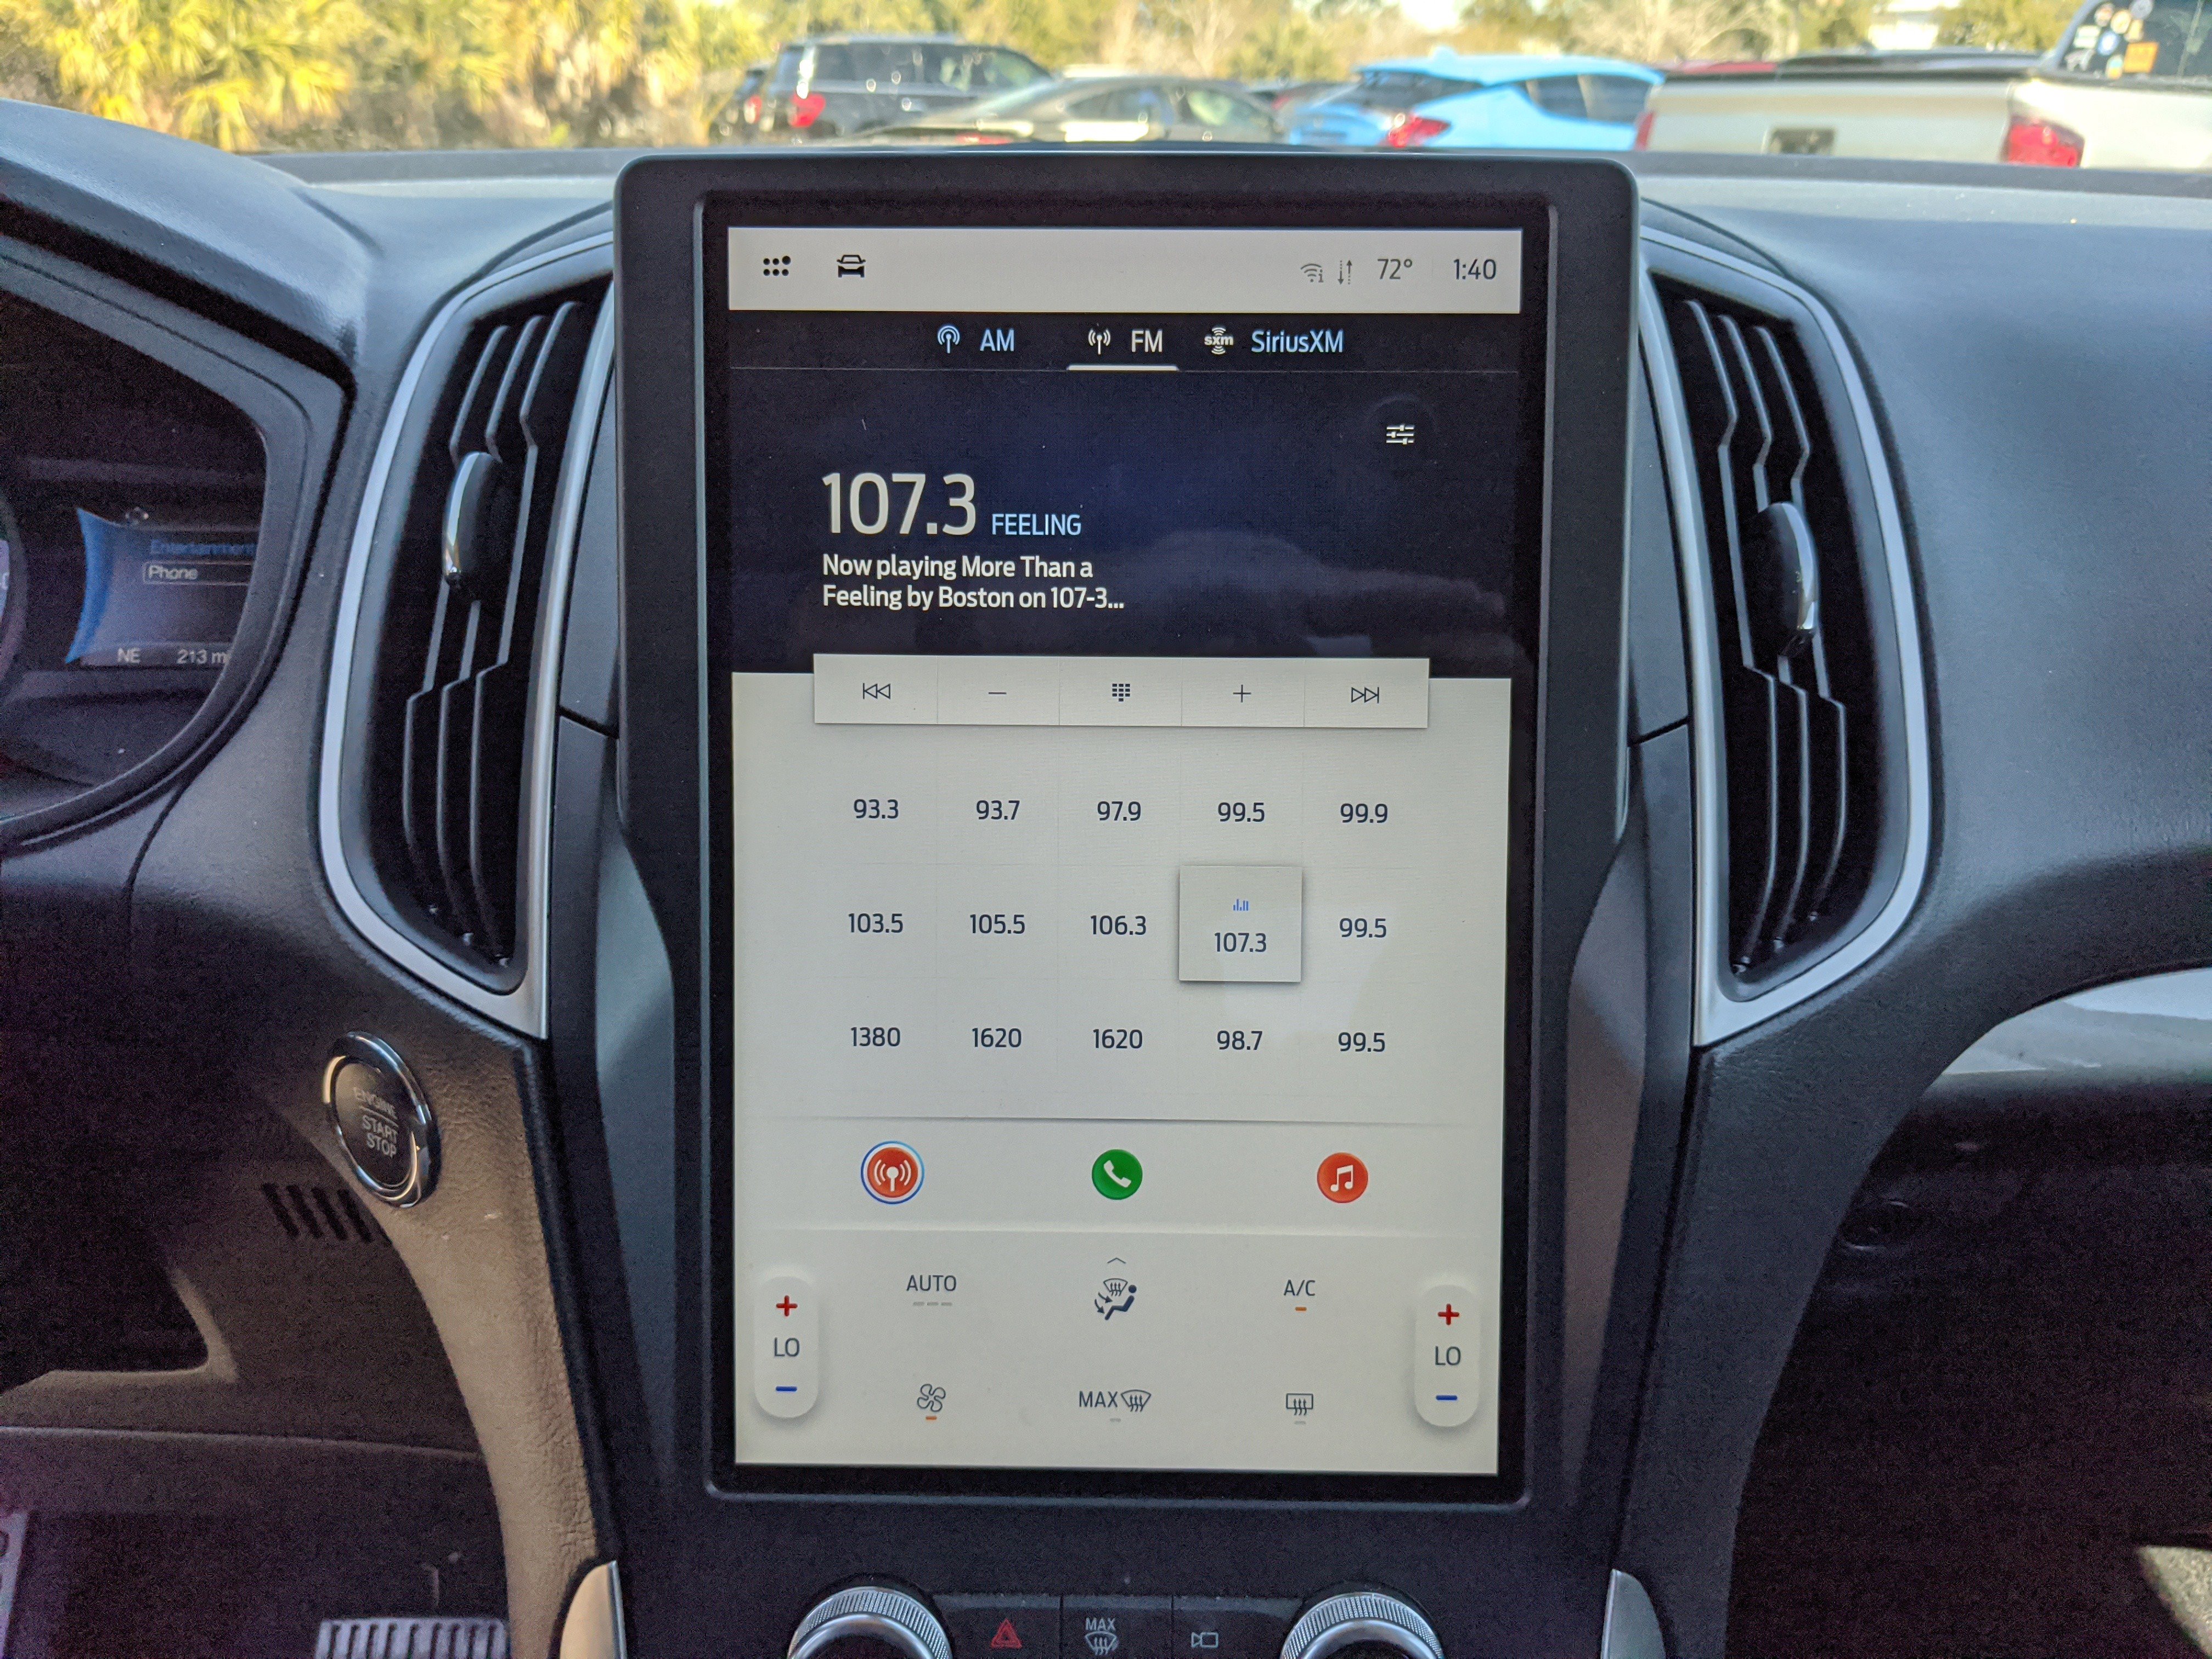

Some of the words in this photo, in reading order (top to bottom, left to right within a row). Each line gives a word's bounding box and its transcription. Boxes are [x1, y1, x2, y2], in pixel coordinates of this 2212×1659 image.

[1377, 258, 1413, 280] 72°
[1453, 258, 1497, 280] 1:40
[980, 329, 1014, 352] AM
[1131, 330, 1163, 352] FM
[1251, 330, 1343, 353] SiriusXM
[822, 472, 976, 535] 107.3
[992, 514, 1081, 535] FEELING
[148, 565, 198, 580] Phone
[823, 554, 872, 576] Now
[877, 554, 957, 580] playing
[962, 555, 1015, 577] More
[1020, 555, 1075, 578] Than
[1080, 561, 1093, 578] a
[823, 584, 902, 611] Feeling
[907, 584, 934, 611] by
[939, 586, 1014, 608] Boston
[1019, 591, 1046, 608] on
[117, 647, 142, 665] NE
[176, 648, 208, 665] 213
[854, 799, 899, 819] 93.3
[976, 800, 1020, 820] 93.7
[1097, 801, 1141, 821] 97.9
[1217, 802, 1265, 822] 99.5
[1340, 803, 1388, 823] 99.9
[848, 913, 904, 933] 103.5
[969, 914, 1025, 934] 105.5
[1090, 915, 1147, 935] 106.3
[1339, 918, 1387, 938] 99.5
[1214, 932, 1267, 952] 107.3
[850, 1026, 901, 1047] 1380
[972, 1028, 1022, 1048] 1620
[1093, 1029, 1143, 1049] 1620
[1217, 1030, 1263, 1051] 98.7
[1338, 1032, 1385, 1052] 99.5
[362, 1114, 398, 1144] START
[366, 1132, 397, 1159] STOP
[906, 1274, 957, 1292] AUTO
[1283, 1279, 1316, 1296] A/C
[774, 1337, 800, 1357] LO
[1435, 1346, 1462, 1366] LO
[1079, 1391, 1118, 1408] MAX
[1085, 1617, 1116, 1630] MAX
